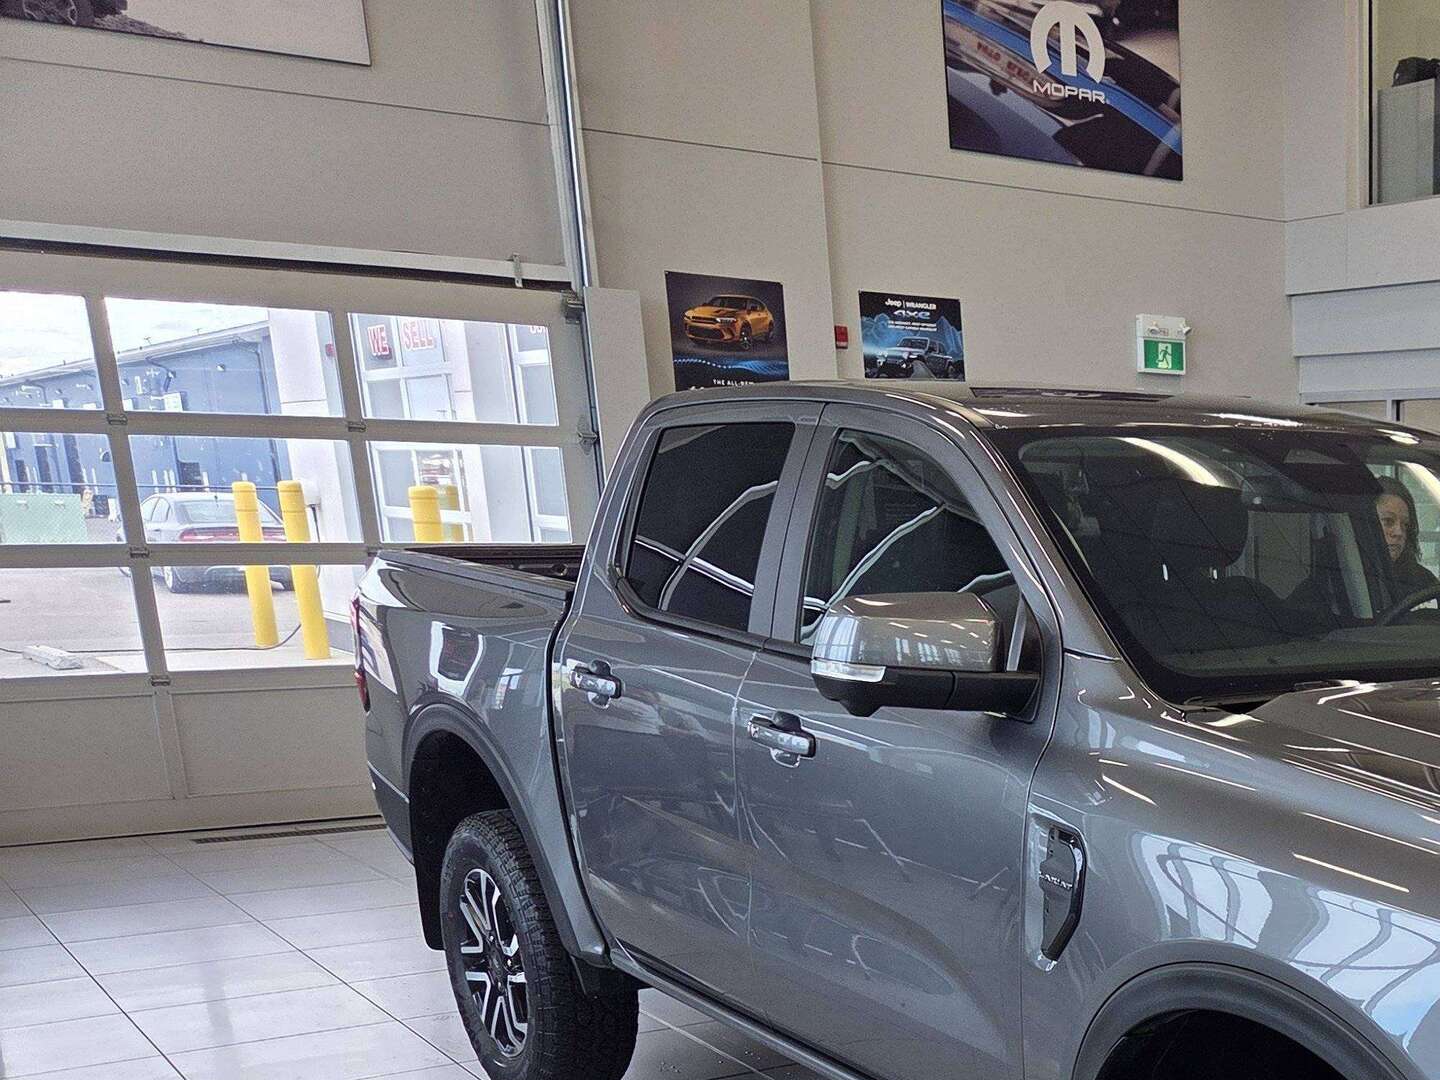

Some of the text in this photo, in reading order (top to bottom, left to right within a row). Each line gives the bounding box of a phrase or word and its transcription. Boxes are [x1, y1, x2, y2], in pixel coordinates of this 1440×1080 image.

[1033, 79, 1107, 104] MOPAR
[885, 299, 937, 310] Jeep WRANGLER
[368, 324, 390, 356] WE
[402, 319, 435, 350] SELL
